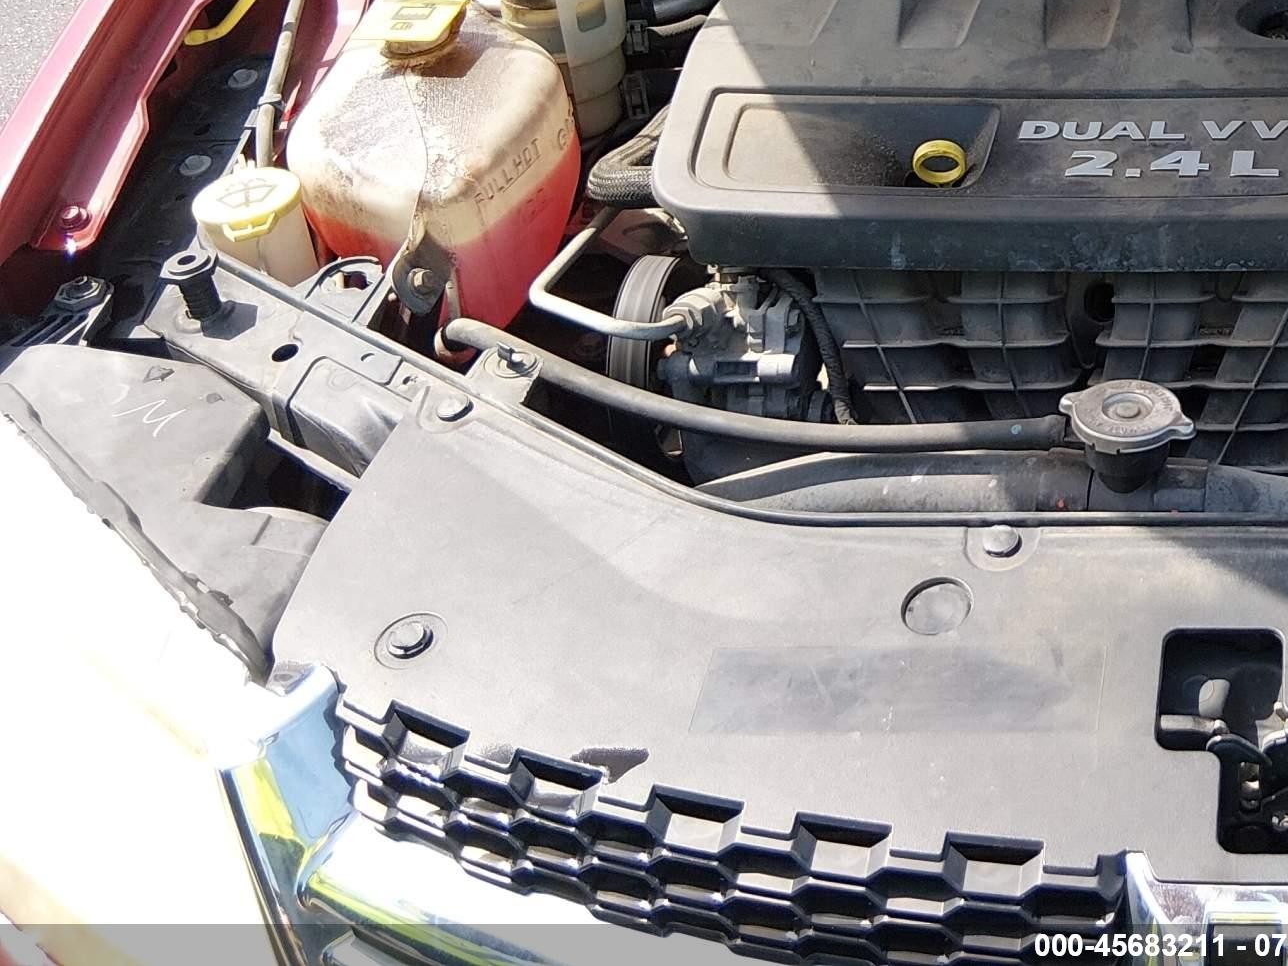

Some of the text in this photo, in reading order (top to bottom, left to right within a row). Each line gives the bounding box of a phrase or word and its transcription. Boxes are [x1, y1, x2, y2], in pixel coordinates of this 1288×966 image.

[1017, 120, 1186, 141] DUAL
[473, 138, 540, 205] FULL HOT
